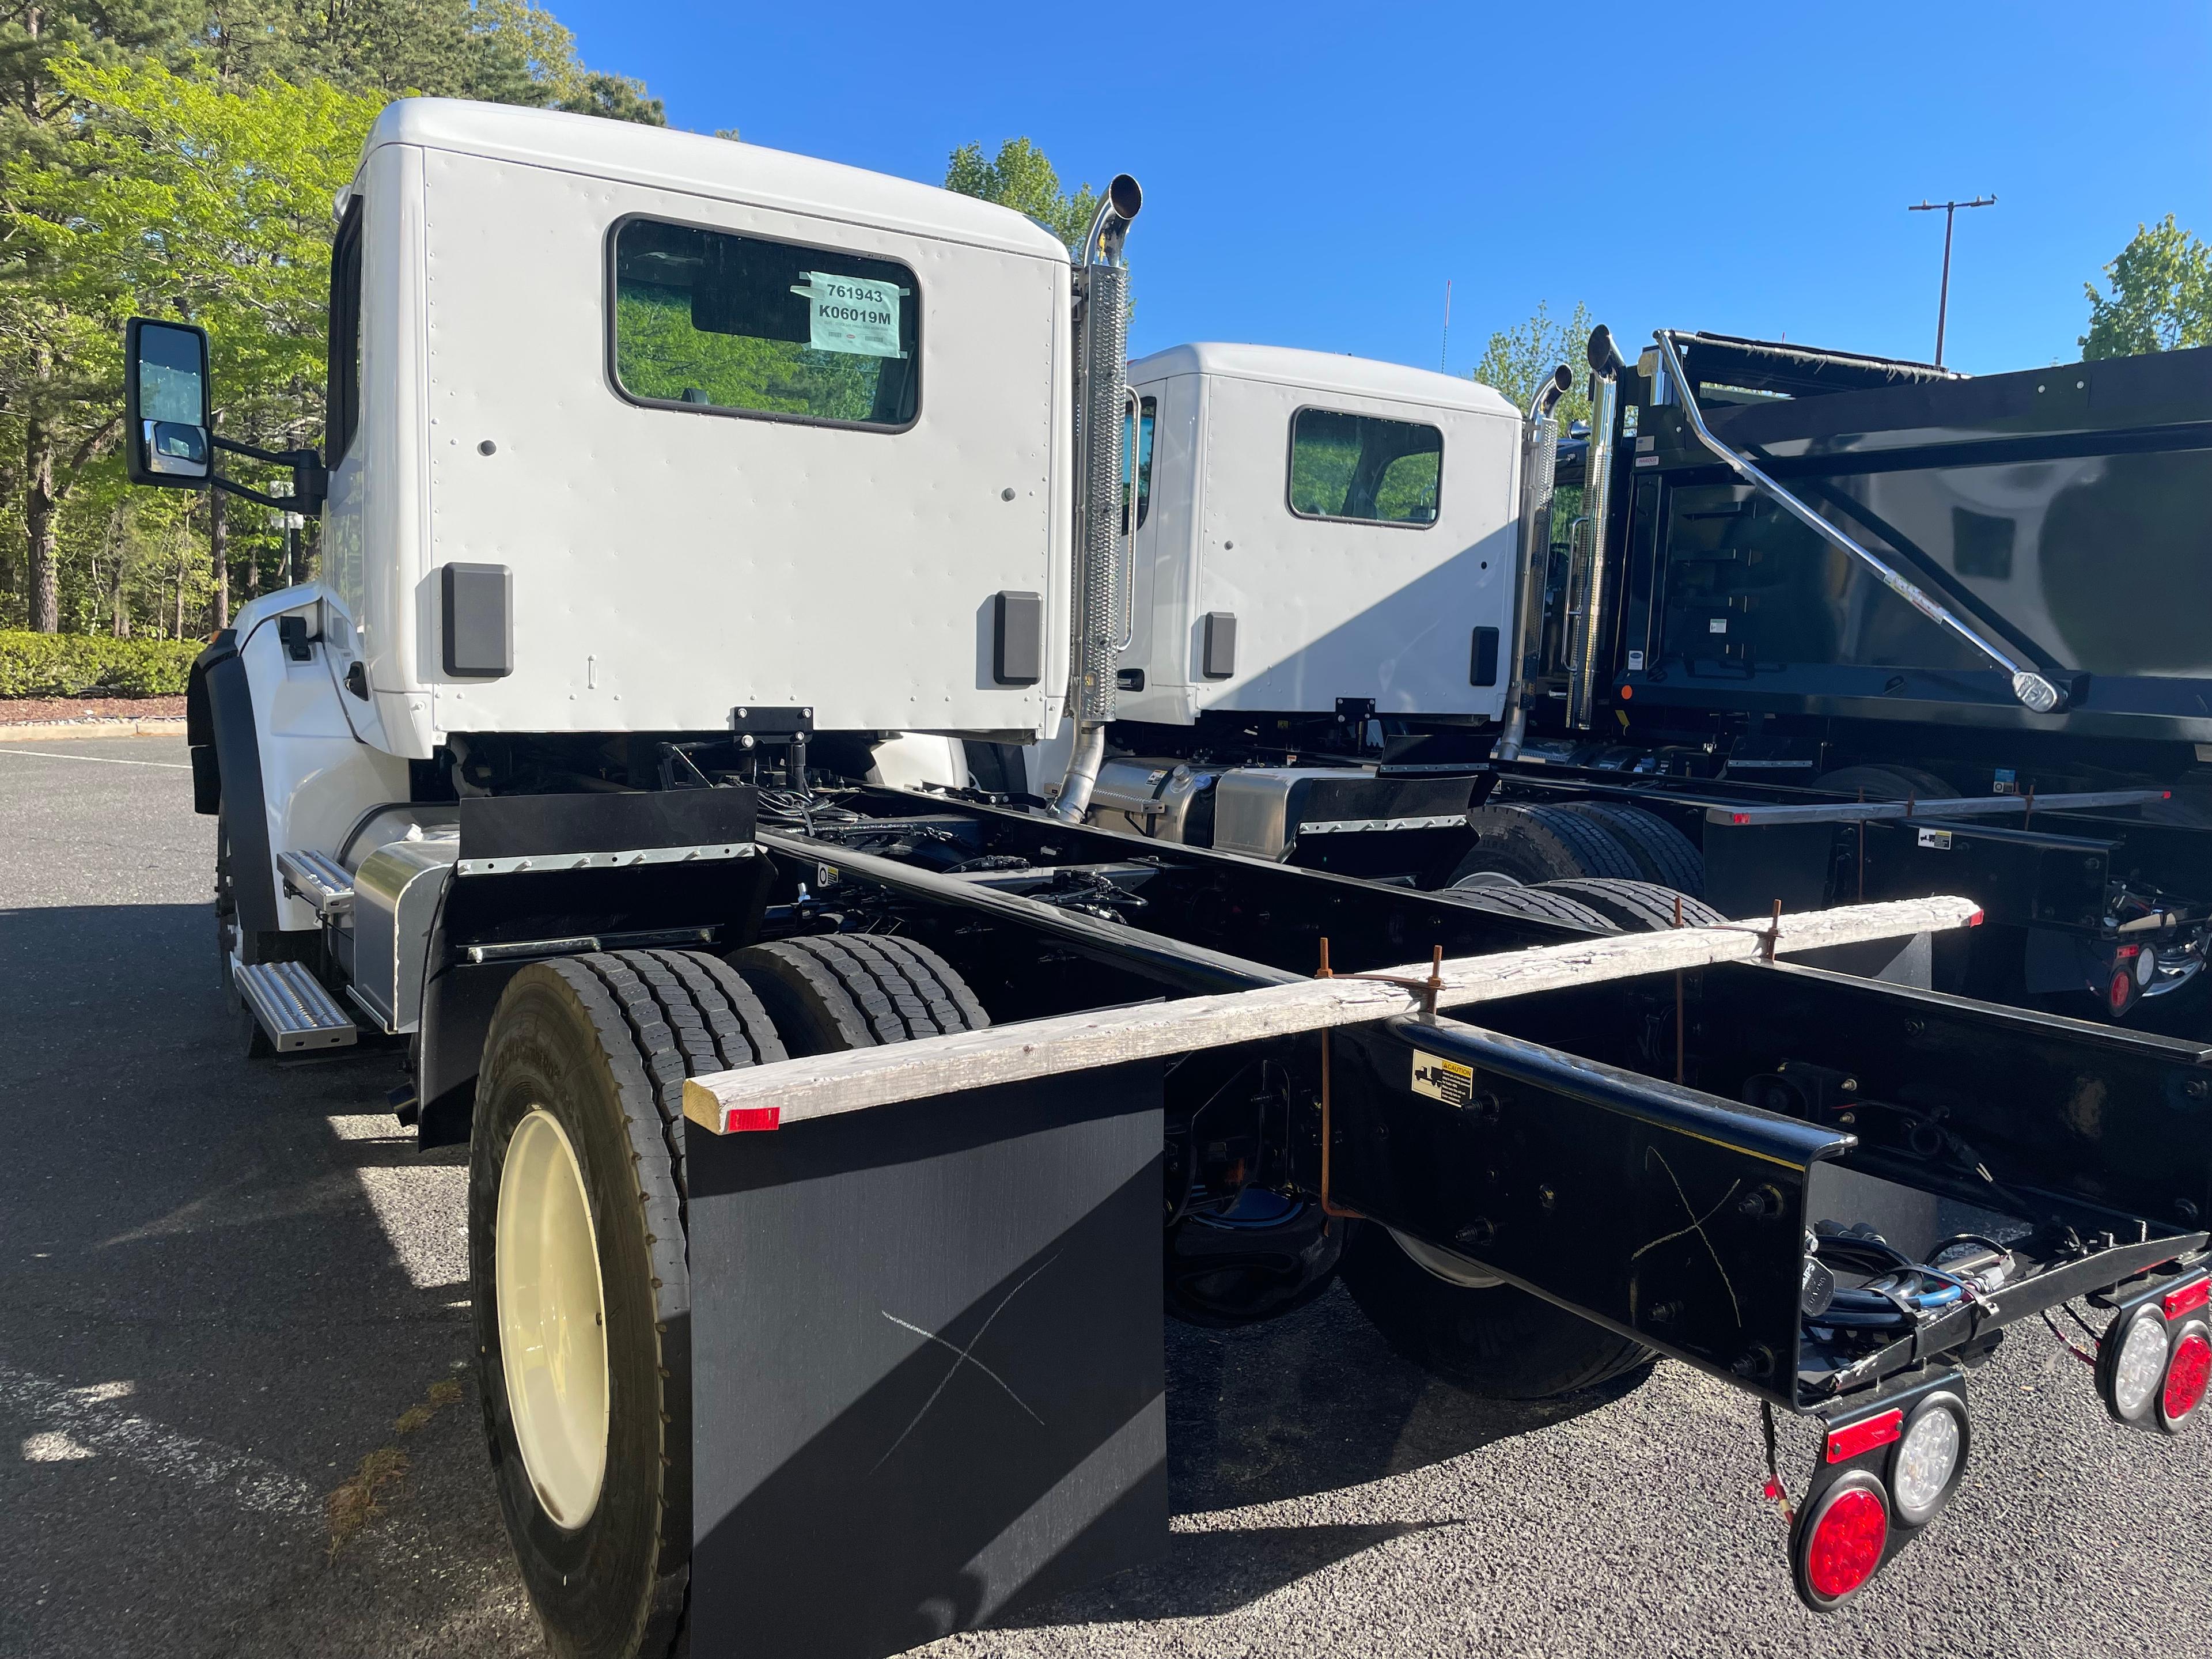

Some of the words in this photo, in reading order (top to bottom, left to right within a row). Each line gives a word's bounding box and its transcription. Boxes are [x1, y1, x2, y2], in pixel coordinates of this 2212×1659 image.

[827, 284, 882, 302] 761943
[819, 305, 891, 325] K06019M
[1447, 1063, 1471, 1076] CAUTION
